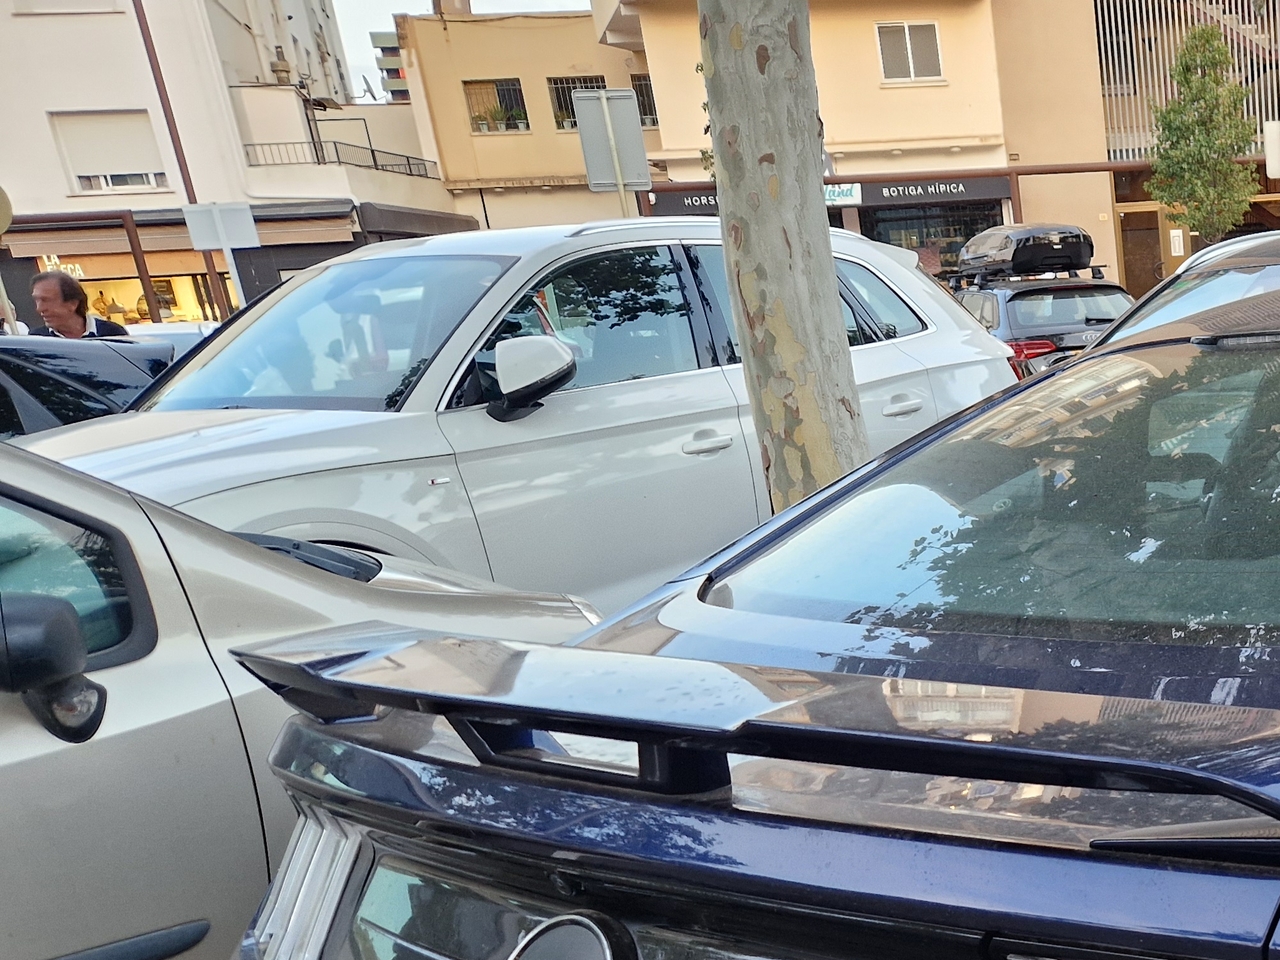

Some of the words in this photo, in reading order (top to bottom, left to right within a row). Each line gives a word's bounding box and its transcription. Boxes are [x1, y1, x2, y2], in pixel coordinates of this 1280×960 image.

[882, 186, 924, 198] BOTIGA
[927, 182, 966, 196] HÍPICA
[684, 194, 719, 207] HORS
[42, 254, 60, 266] LA
[46, 263, 85, 277] FECA
